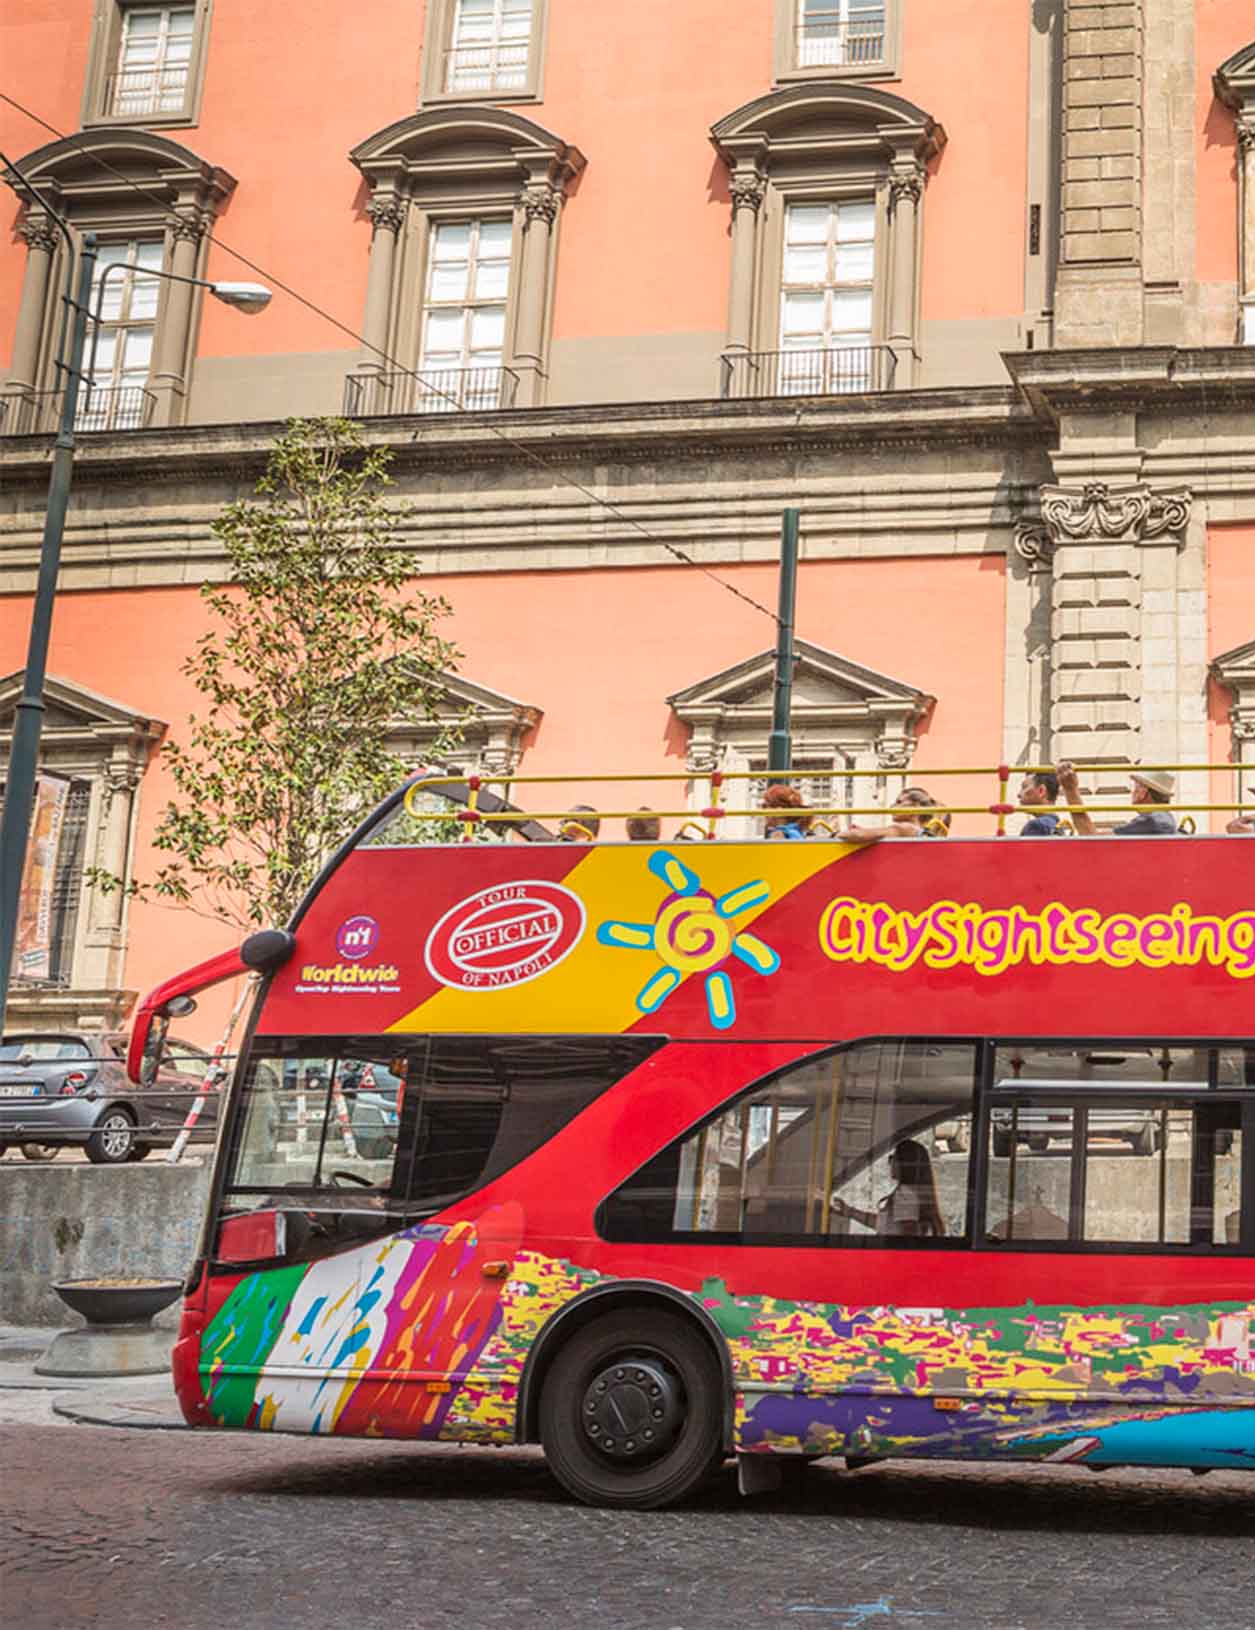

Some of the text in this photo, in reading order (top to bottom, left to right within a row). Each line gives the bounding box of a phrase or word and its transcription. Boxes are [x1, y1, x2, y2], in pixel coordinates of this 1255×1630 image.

[477, 887, 528, 908] TOUR
[456, 917, 556, 954] OFFICIAL
[462, 953, 554, 986] OF NAPOLI
